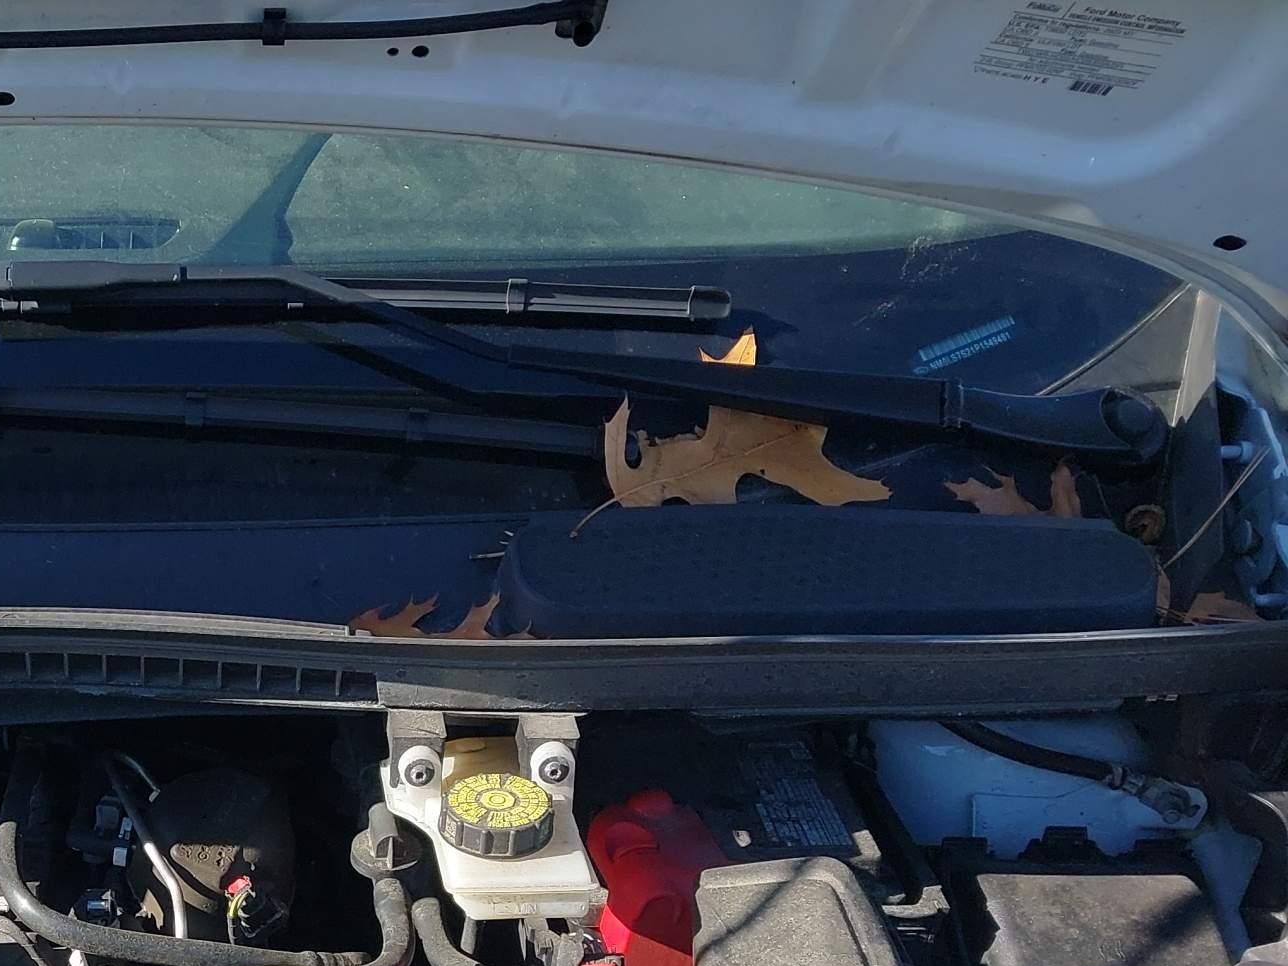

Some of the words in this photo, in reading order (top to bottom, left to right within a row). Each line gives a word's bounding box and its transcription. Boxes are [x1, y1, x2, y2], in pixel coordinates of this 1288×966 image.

[1084, 7, 1105, 16] Ford
[1109, 10, 1136, 20] Motor
[1137, 14, 1182, 26] Company
